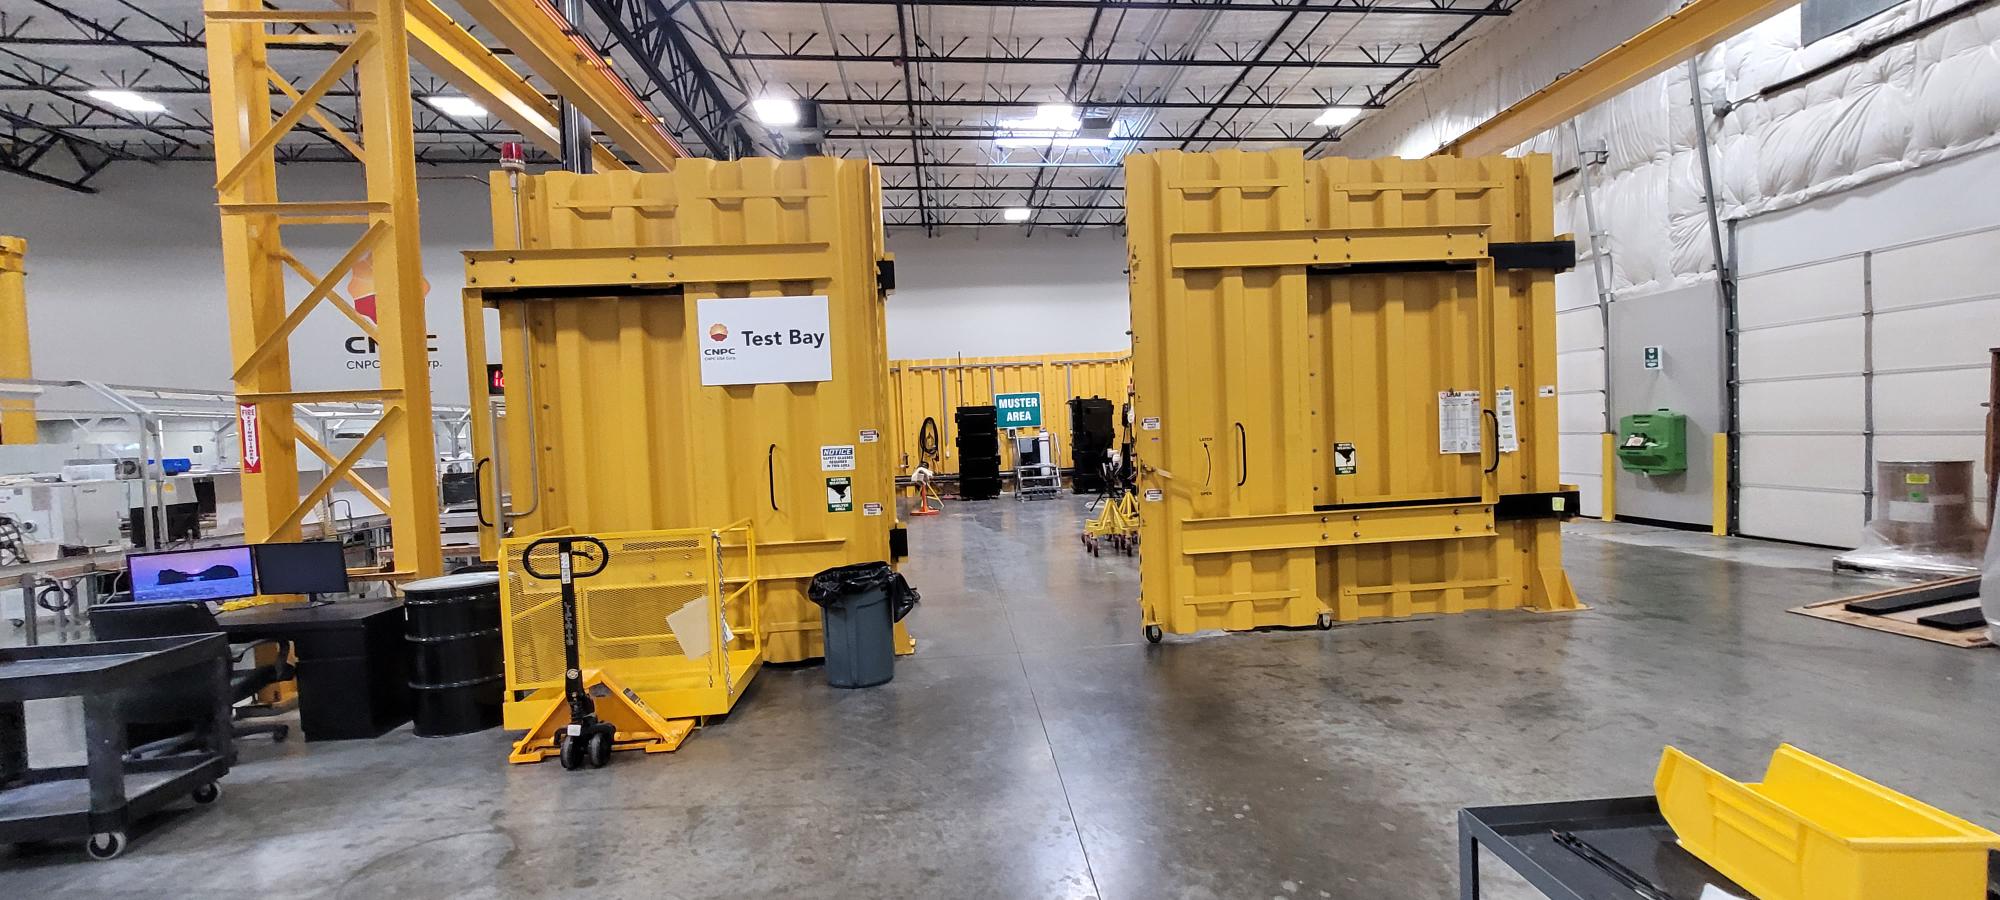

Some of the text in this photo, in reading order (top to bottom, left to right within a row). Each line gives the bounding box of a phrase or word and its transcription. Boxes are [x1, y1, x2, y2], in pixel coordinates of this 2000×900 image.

[741, 329, 825, 348] Test Bay
[999, 398, 1037, 409] MUSTER
[1007, 411, 1031, 421] AREA
[823, 448, 852, 456] NOTICE
